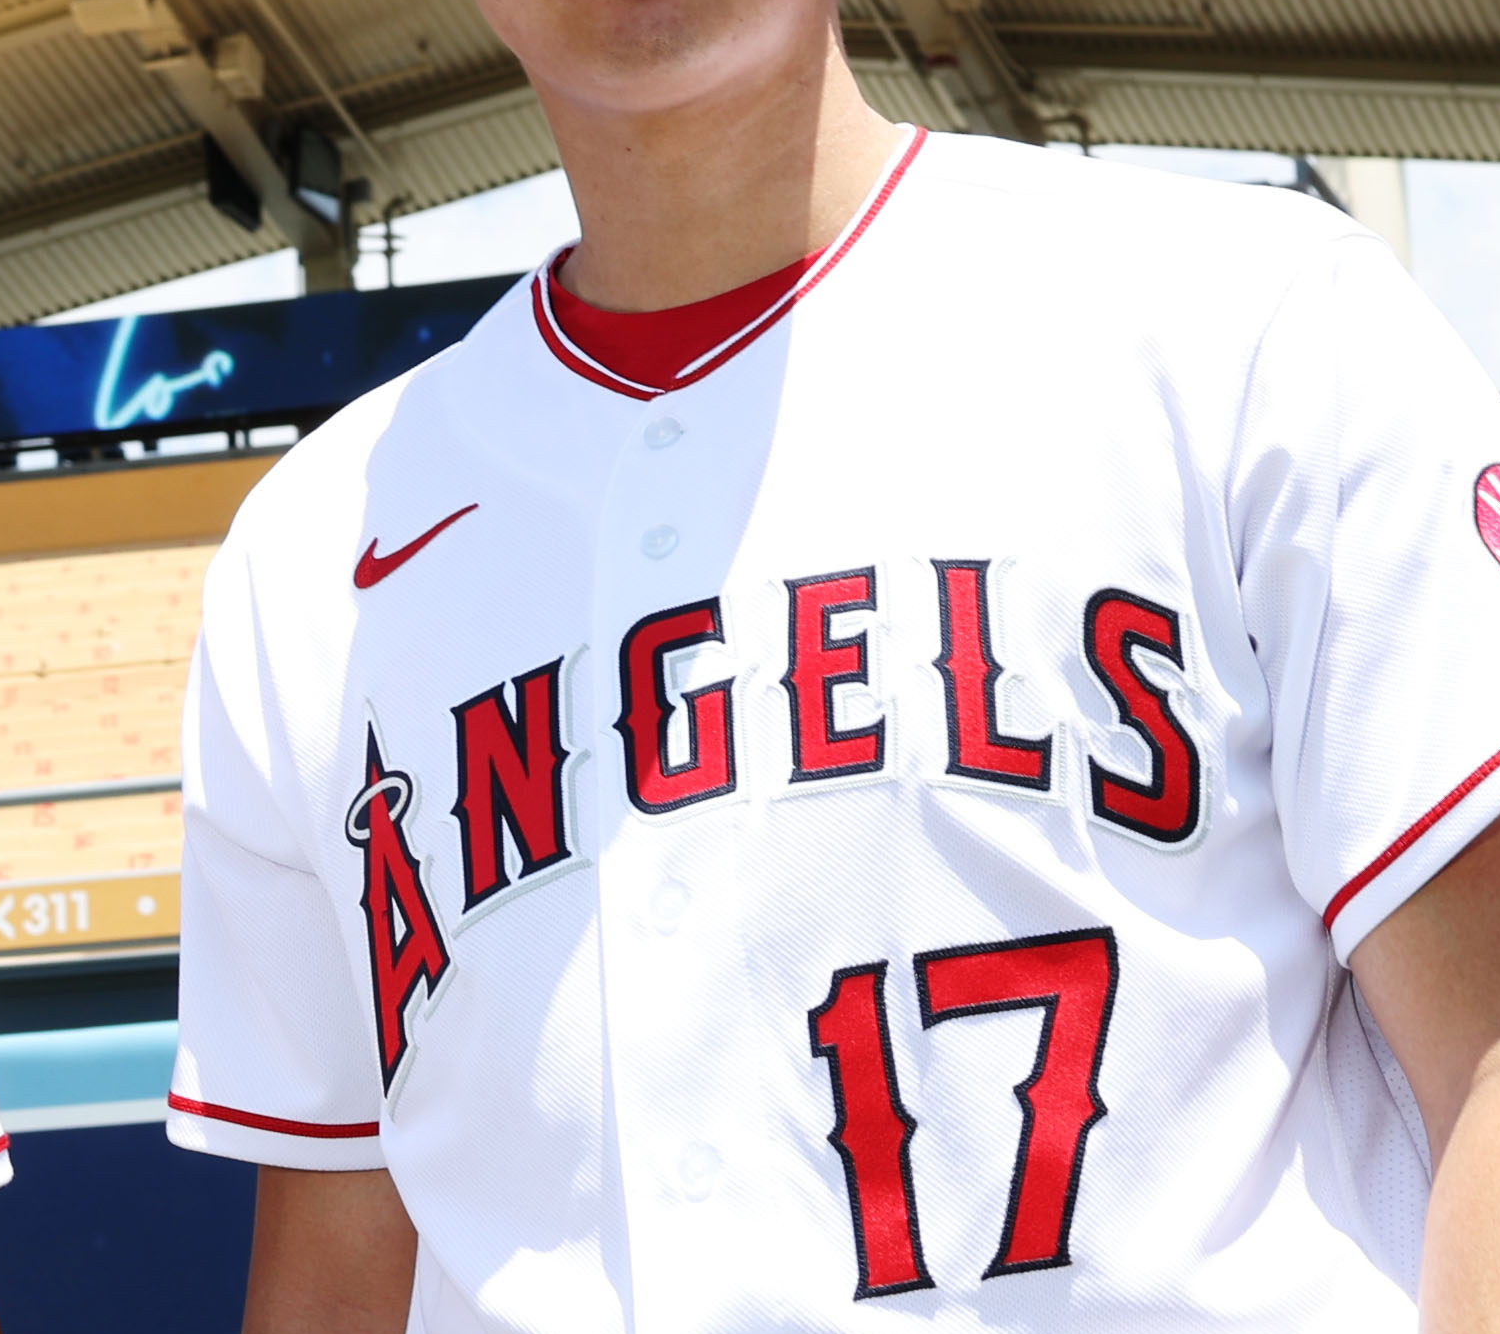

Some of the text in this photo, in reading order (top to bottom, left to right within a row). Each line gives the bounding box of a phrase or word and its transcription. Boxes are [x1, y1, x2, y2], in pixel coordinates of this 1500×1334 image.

[21, 880, 90, 937] 311
[344, 558, 1207, 1097] ANGELS
[806, 925, 1120, 1302] 17
